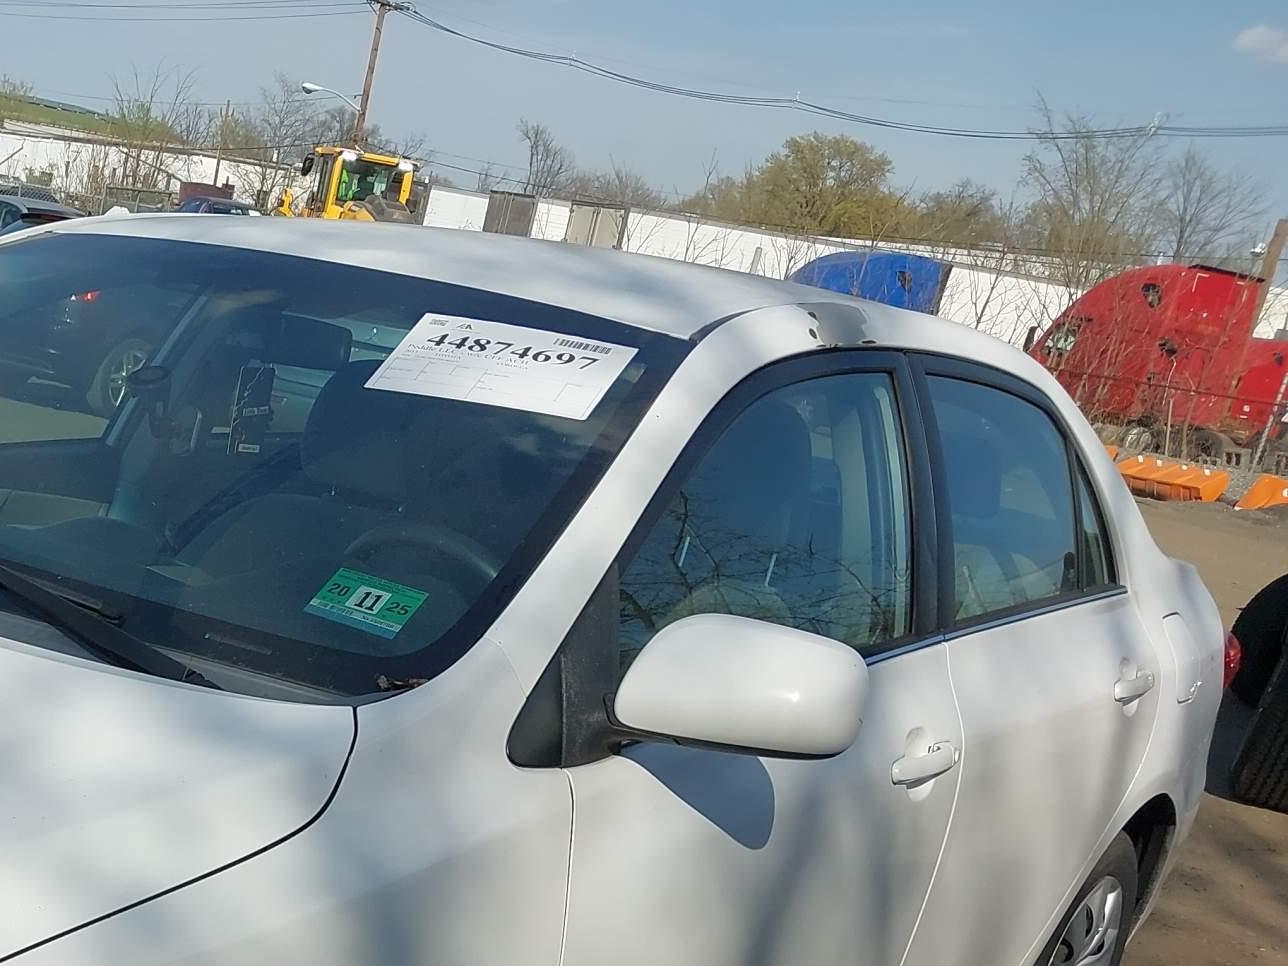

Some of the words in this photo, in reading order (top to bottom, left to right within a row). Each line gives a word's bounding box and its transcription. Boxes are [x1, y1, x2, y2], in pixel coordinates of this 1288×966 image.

[426, 333, 601, 371] 44874697
[327, 583, 351, 597] 20
[354, 591, 384, 612] 11
[386, 601, 412, 616] 25
